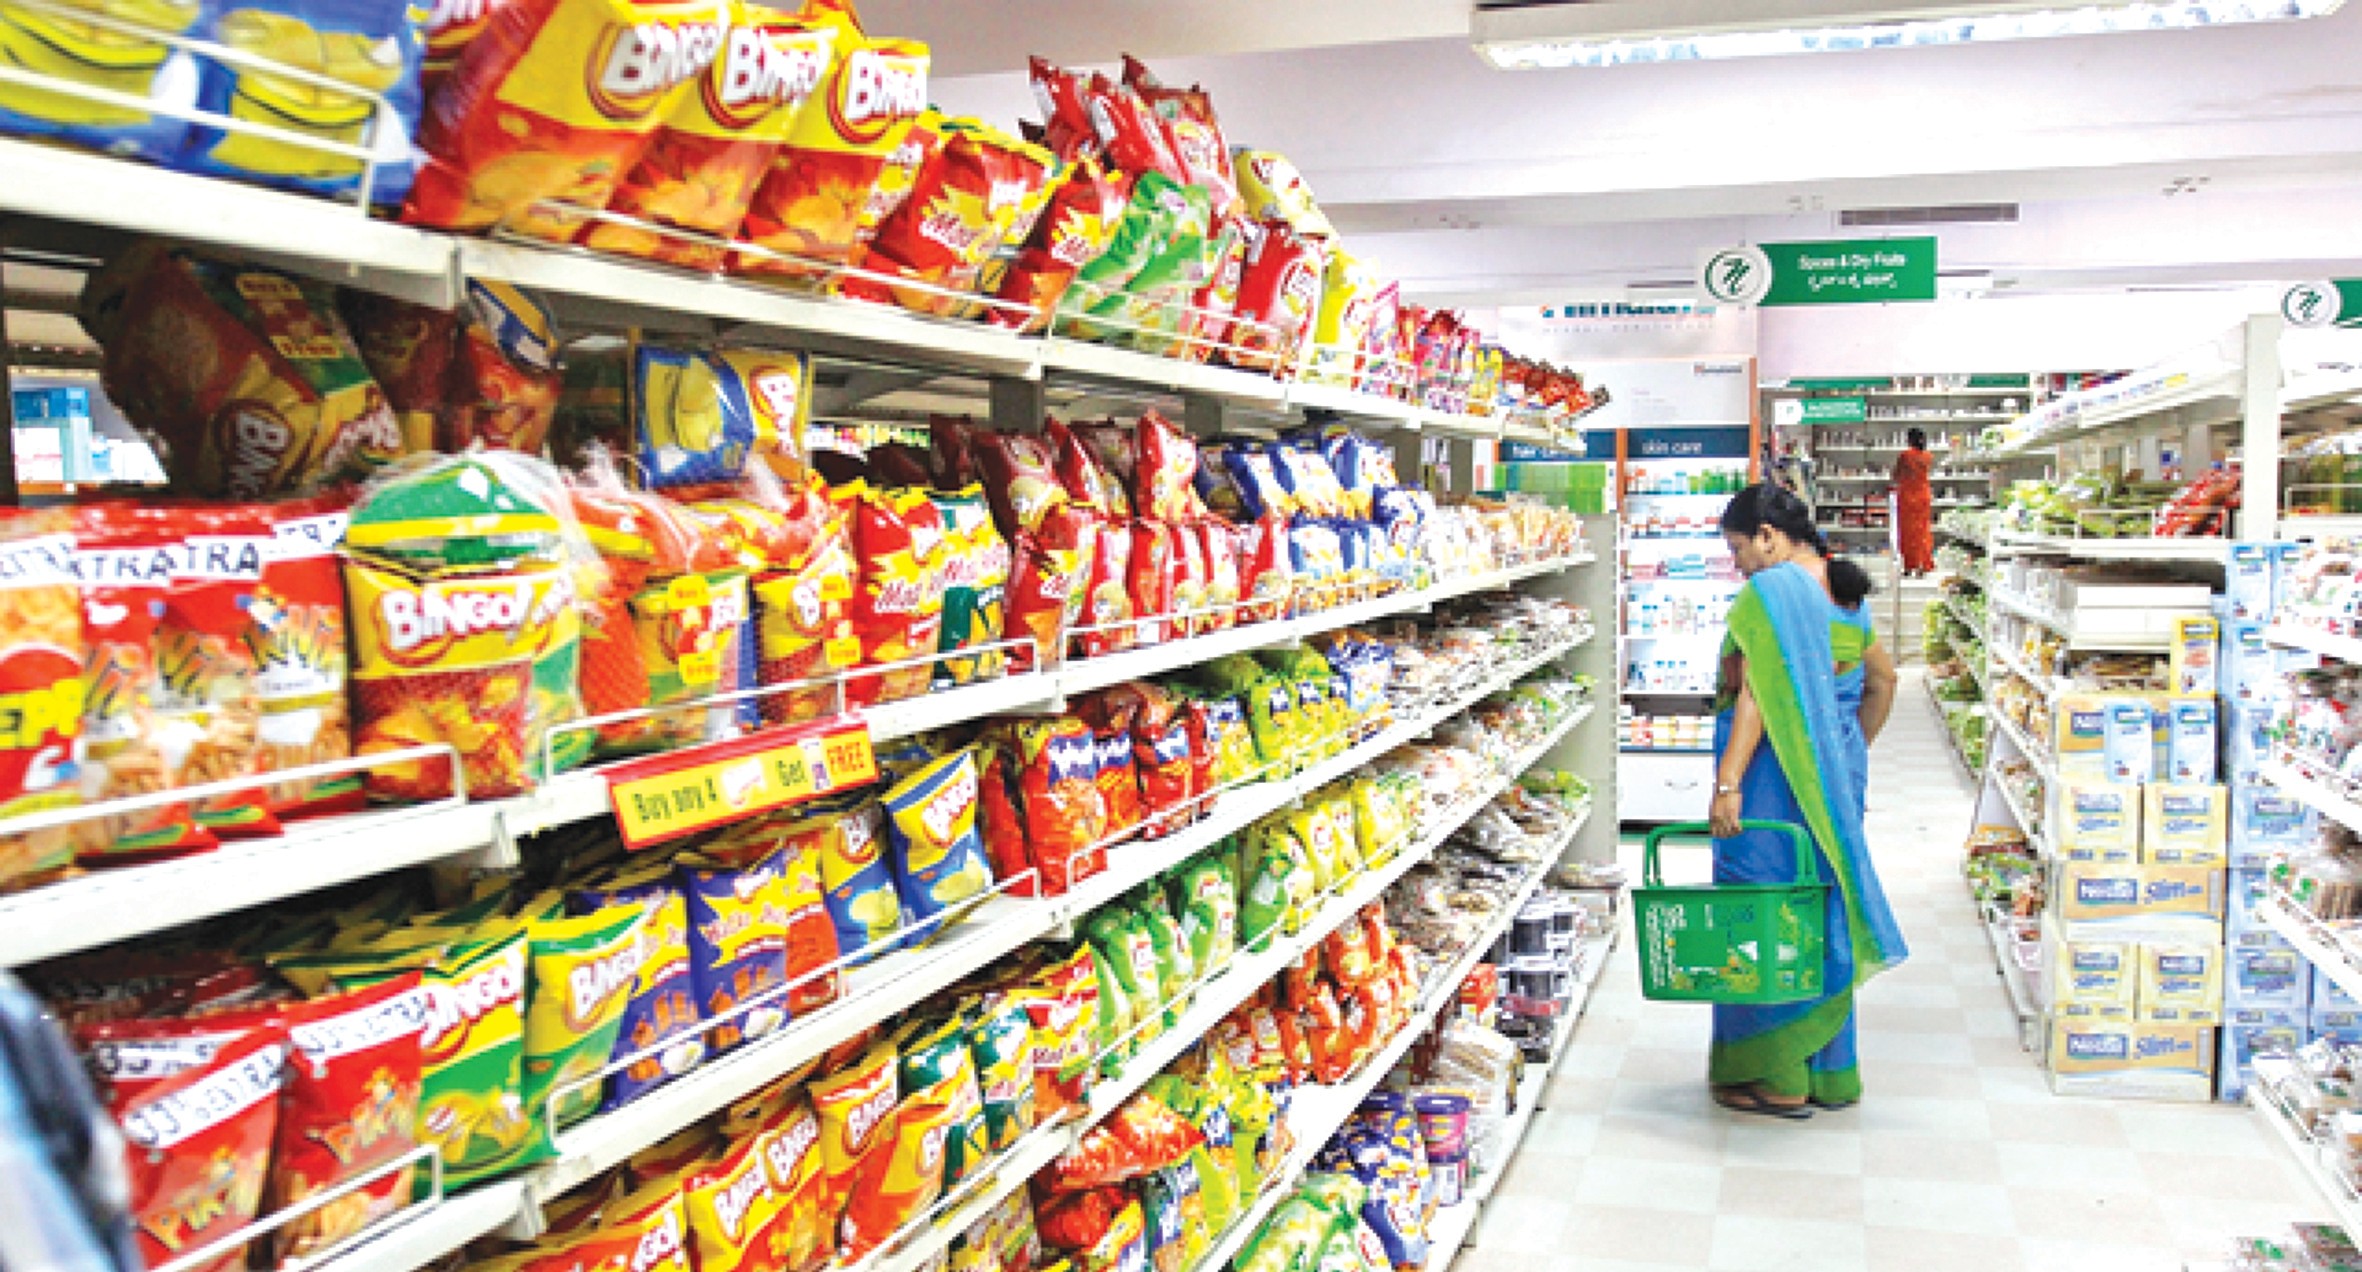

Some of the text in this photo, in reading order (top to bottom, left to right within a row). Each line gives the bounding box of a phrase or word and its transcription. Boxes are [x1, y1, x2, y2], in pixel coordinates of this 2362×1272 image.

[631, 791, 673, 824] Buy
[671, 785, 705, 814] any
[775, 759, 810, 787] Get
[826, 740, 866, 774] FREE
